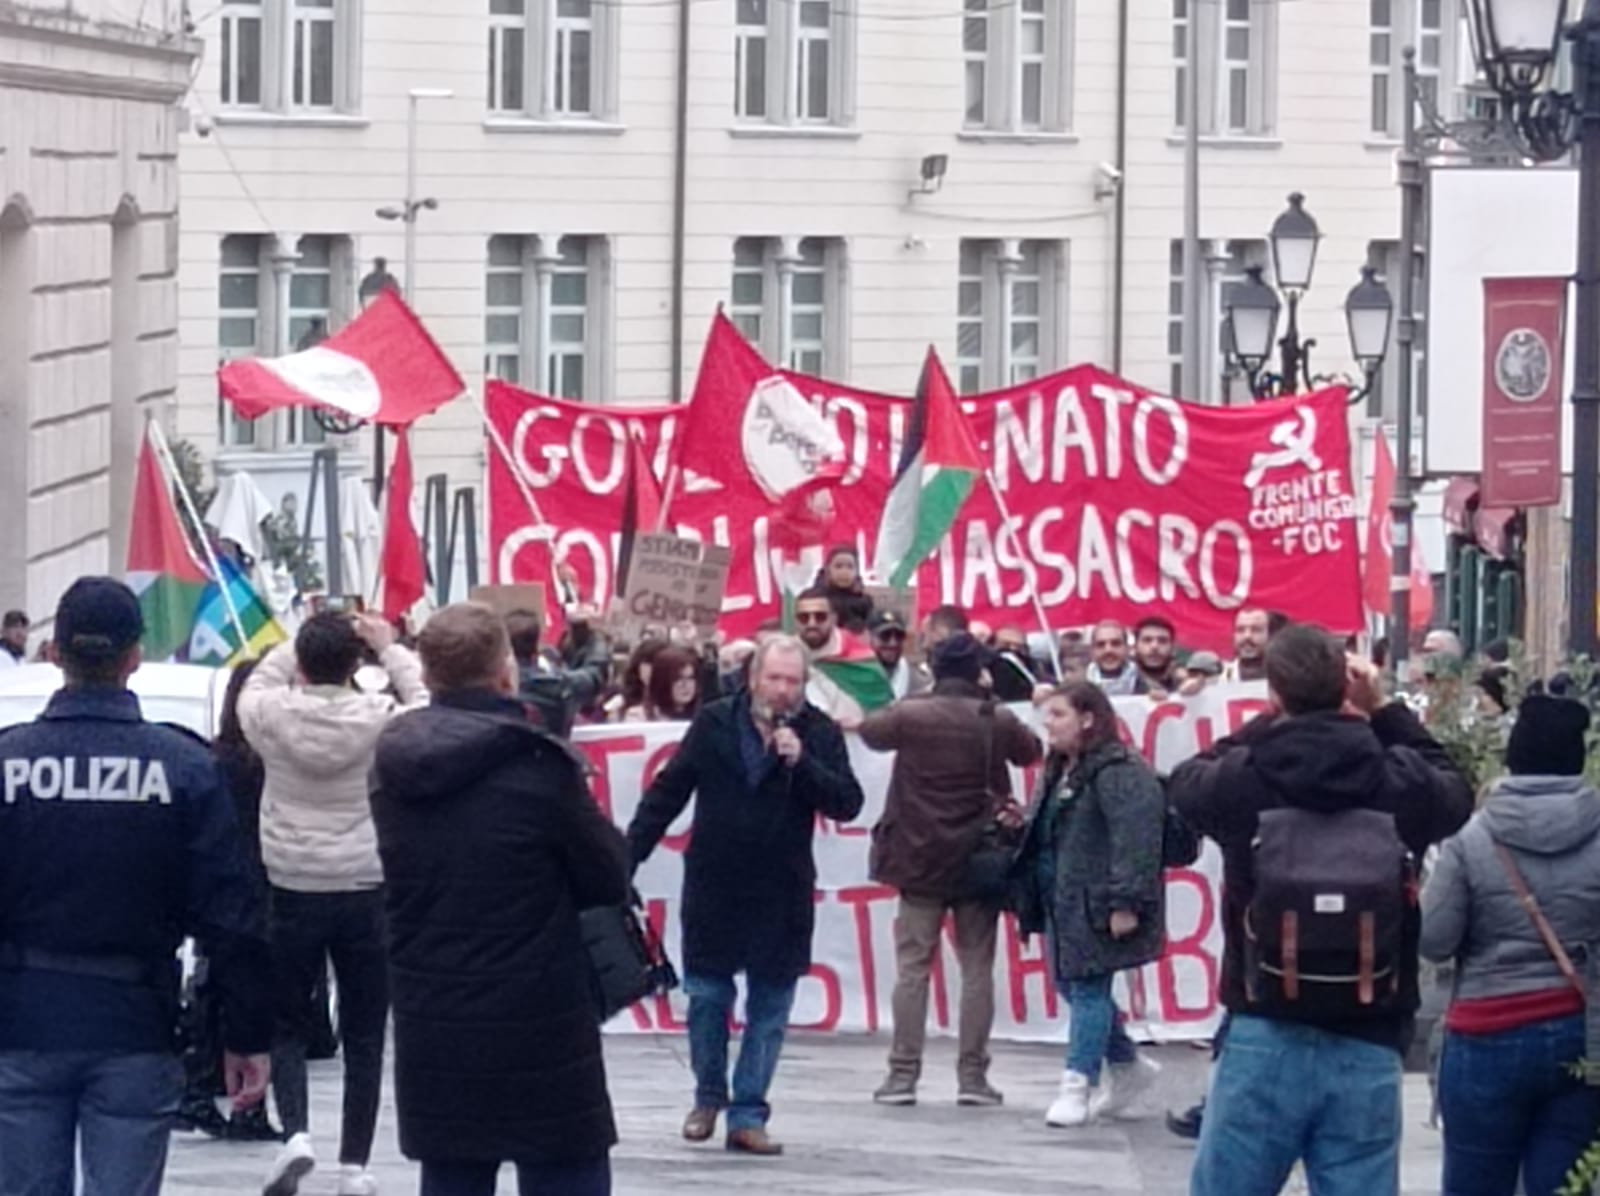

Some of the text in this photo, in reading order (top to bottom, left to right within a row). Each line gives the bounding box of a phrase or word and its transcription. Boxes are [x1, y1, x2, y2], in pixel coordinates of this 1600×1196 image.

[993, 383, 1189, 490] NATO
[1251, 468, 1341, 508] FRONTE
[4, 756, 172, 804] POLIZIA
